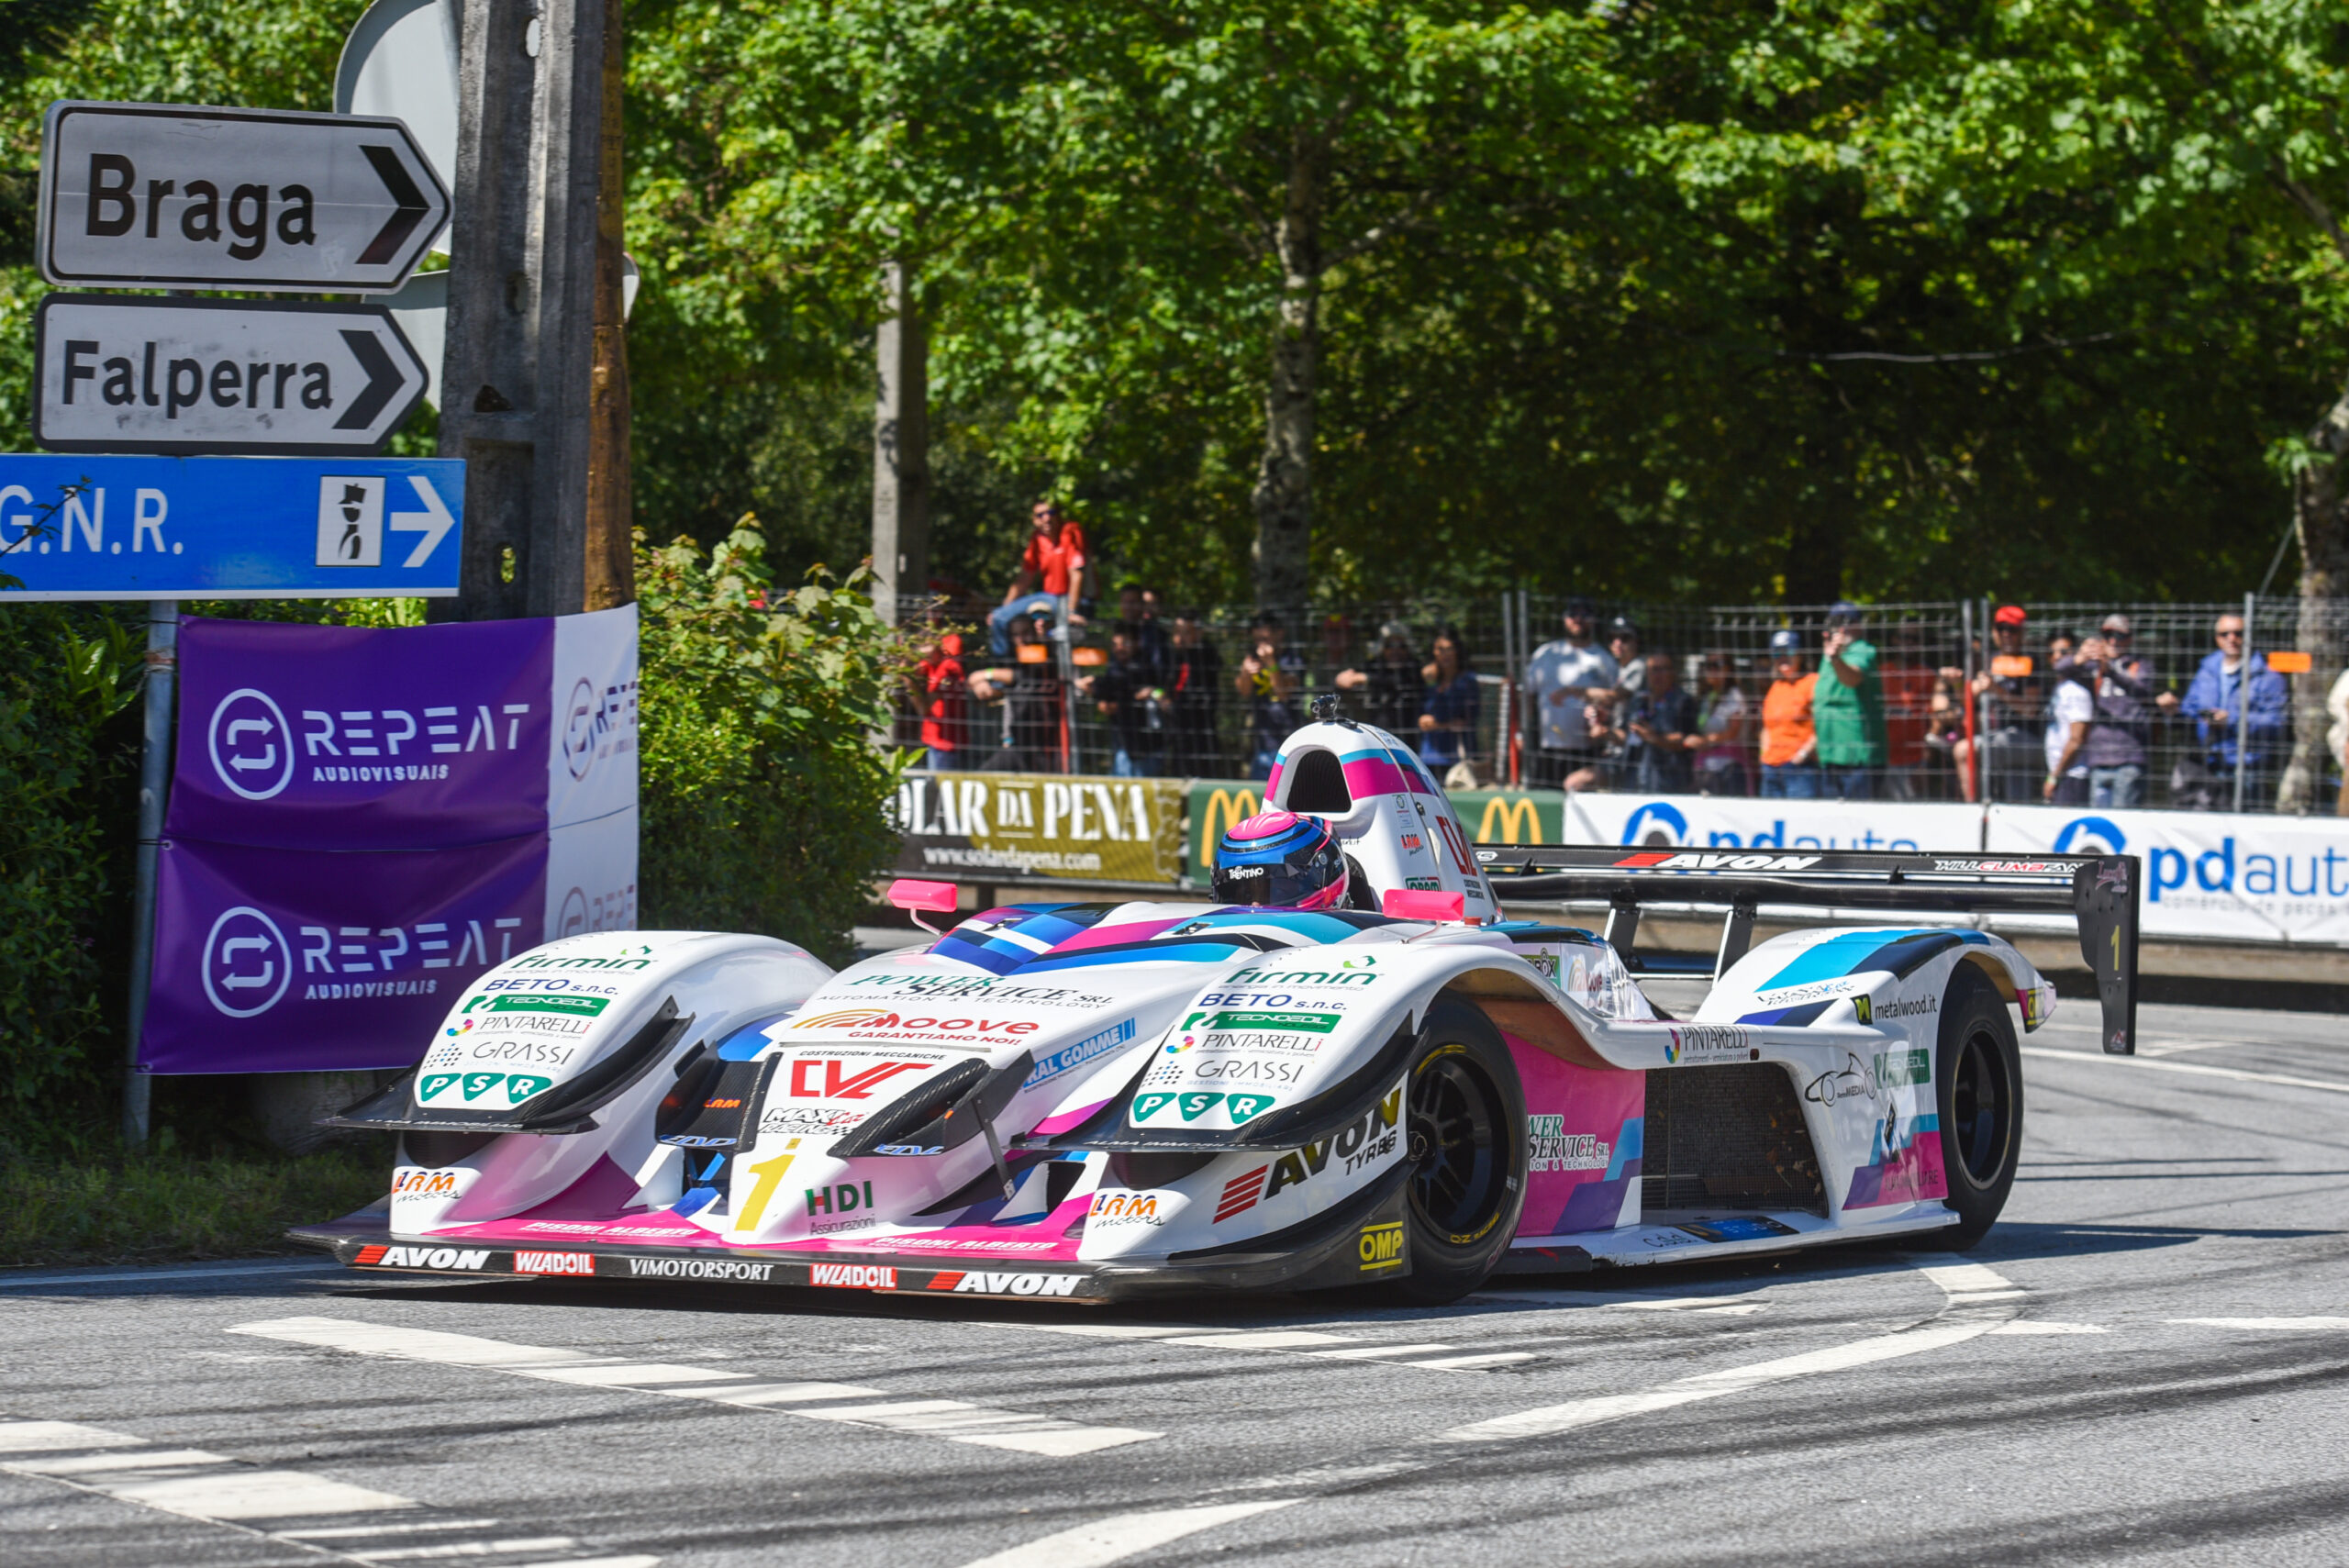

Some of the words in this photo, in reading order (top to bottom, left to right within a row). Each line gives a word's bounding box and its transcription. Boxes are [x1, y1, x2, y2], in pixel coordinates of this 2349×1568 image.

[85, 152, 317, 261] Braga
[61, 339, 334, 419] Falperra
[0, 484, 184, 555] G.N.R.
[302, 704, 530, 756] REPEAT
[313, 764, 450, 782] AUDIOVISUAIS
[997, 789, 1035, 828] DA
[1043, 782, 1151, 842] PENA
[1228, 865, 1264, 880] TRENTINO
[1654, 854, 1823, 870] AVON
[300, 917, 522, 973] REPEAT
[2110, 925, 2121, 972] 1
[510, 954, 653, 971] firmin
[483, 979, 571, 992] BETO
[570, 984, 619, 995] s.n.c.
[845, 974, 1007, 987] POWER
[1225, 967, 1377, 985] firmin
[305, 979, 439, 1000] AUDIOVISUAIS
[894, 984, 1078, 1000] SERVICE
[1074, 994, 1115, 1004] SRL
[974, 996, 1107, 1010] TECHNOLOGY
[1198, 994, 1293, 1007] BETO
[1294, 1000, 1348, 1010] s.n.c.
[1875, 994, 1937, 1020] metalwood.it
[1226, 1014, 1330, 1025] TECNOEDIL
[848, 1031, 977, 1041] GARANTIAMO
[981, 1036, 1022, 1046] NOI!
[1060, 1026, 1123, 1068] GOMME
[473, 1041, 574, 1065] GRASSI
[874, 1051, 946, 1061] MECCANICHE
[1195, 1060, 1305, 1083] GRASSI
[1264, 1086, 1402, 1200] AVON
[1529, 1133, 1596, 1159] SERVICE
[735, 1154, 796, 1231] 1
[805, 1180, 874, 1217] HDI
[607, 1226, 701, 1237] ALBERTO
[810, 1213, 876, 1235] Assicurazioni
[956, 1240, 1060, 1251] ALBERTO
[1360, 1230, 1404, 1262] OMP
[379, 1246, 491, 1271] AVON
[629, 1258, 774, 1281] VIMOTORSPORT
[953, 1272, 1084, 1296] AVON
